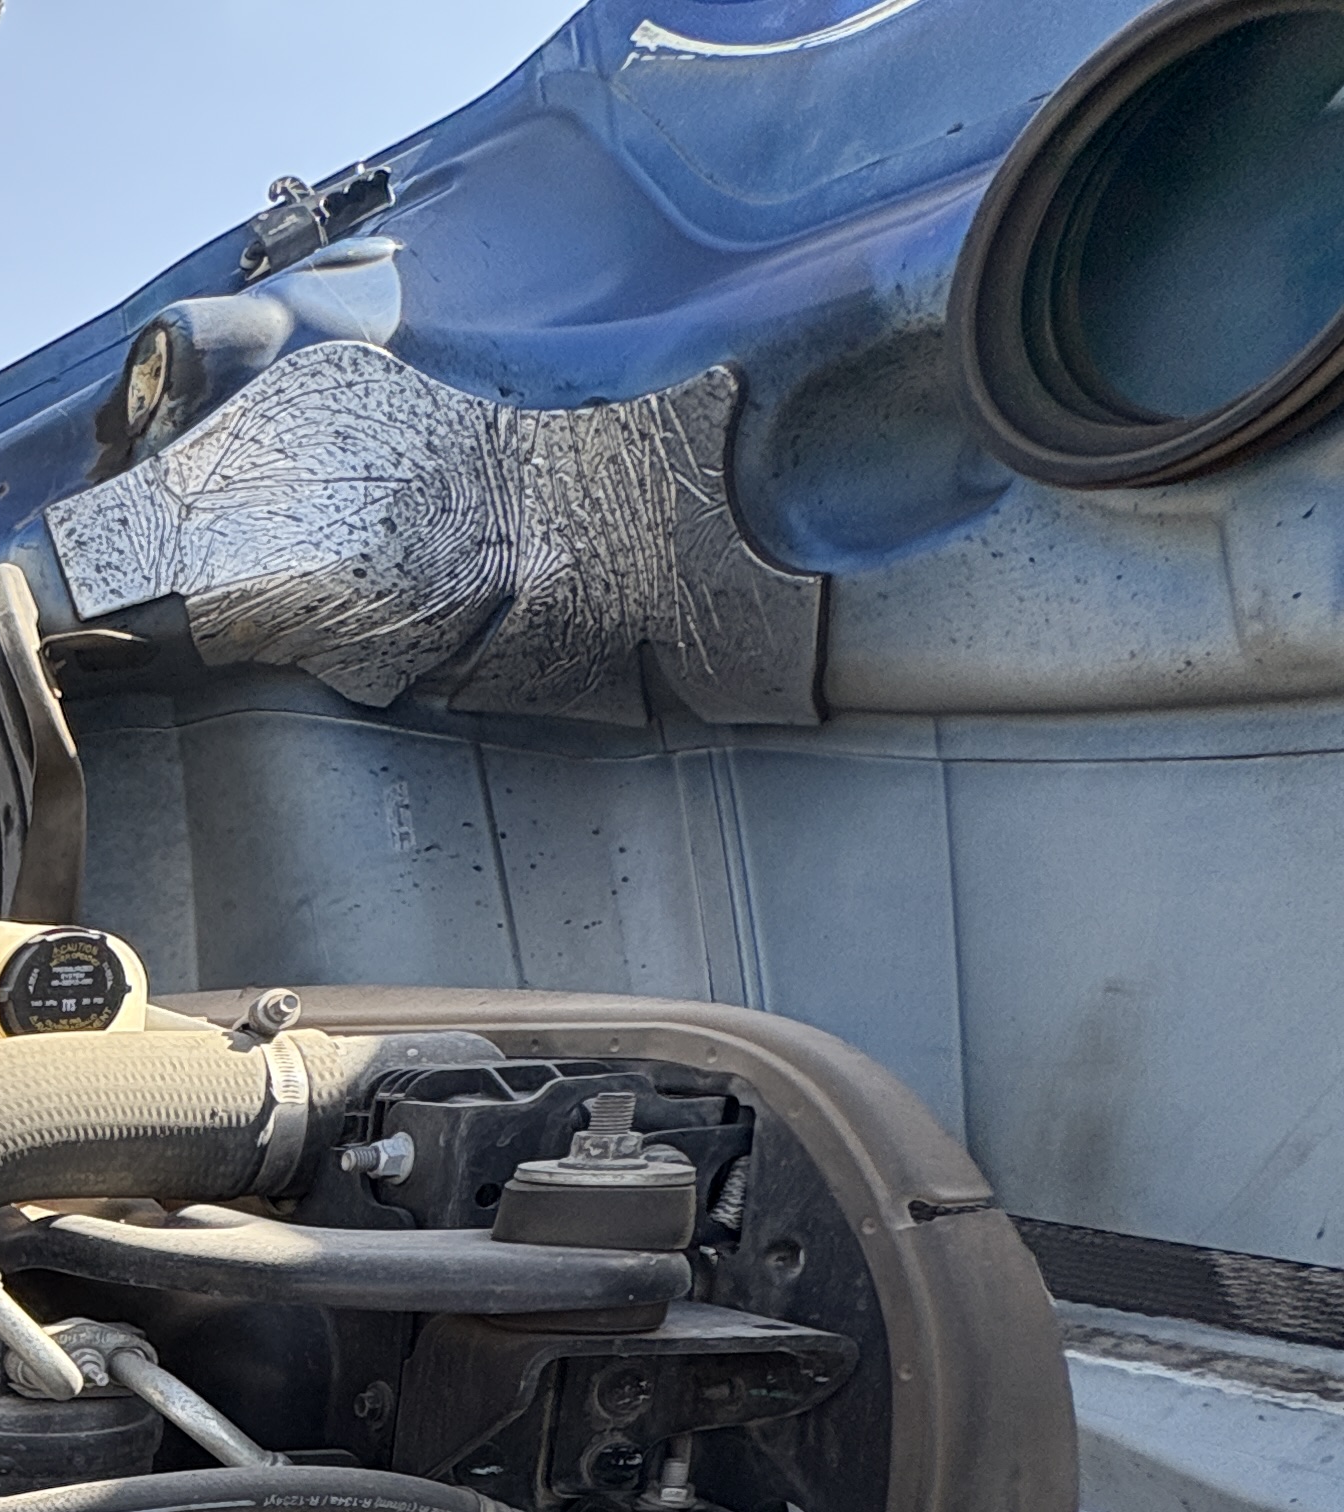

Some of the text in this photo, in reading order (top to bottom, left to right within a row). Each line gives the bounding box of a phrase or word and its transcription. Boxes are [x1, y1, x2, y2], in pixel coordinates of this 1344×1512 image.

[60, 942, 99, 955] CAUTION
[263, 1494, 320, 1507] R-1234yf
[330, 1496, 372, 1508] R-134a
